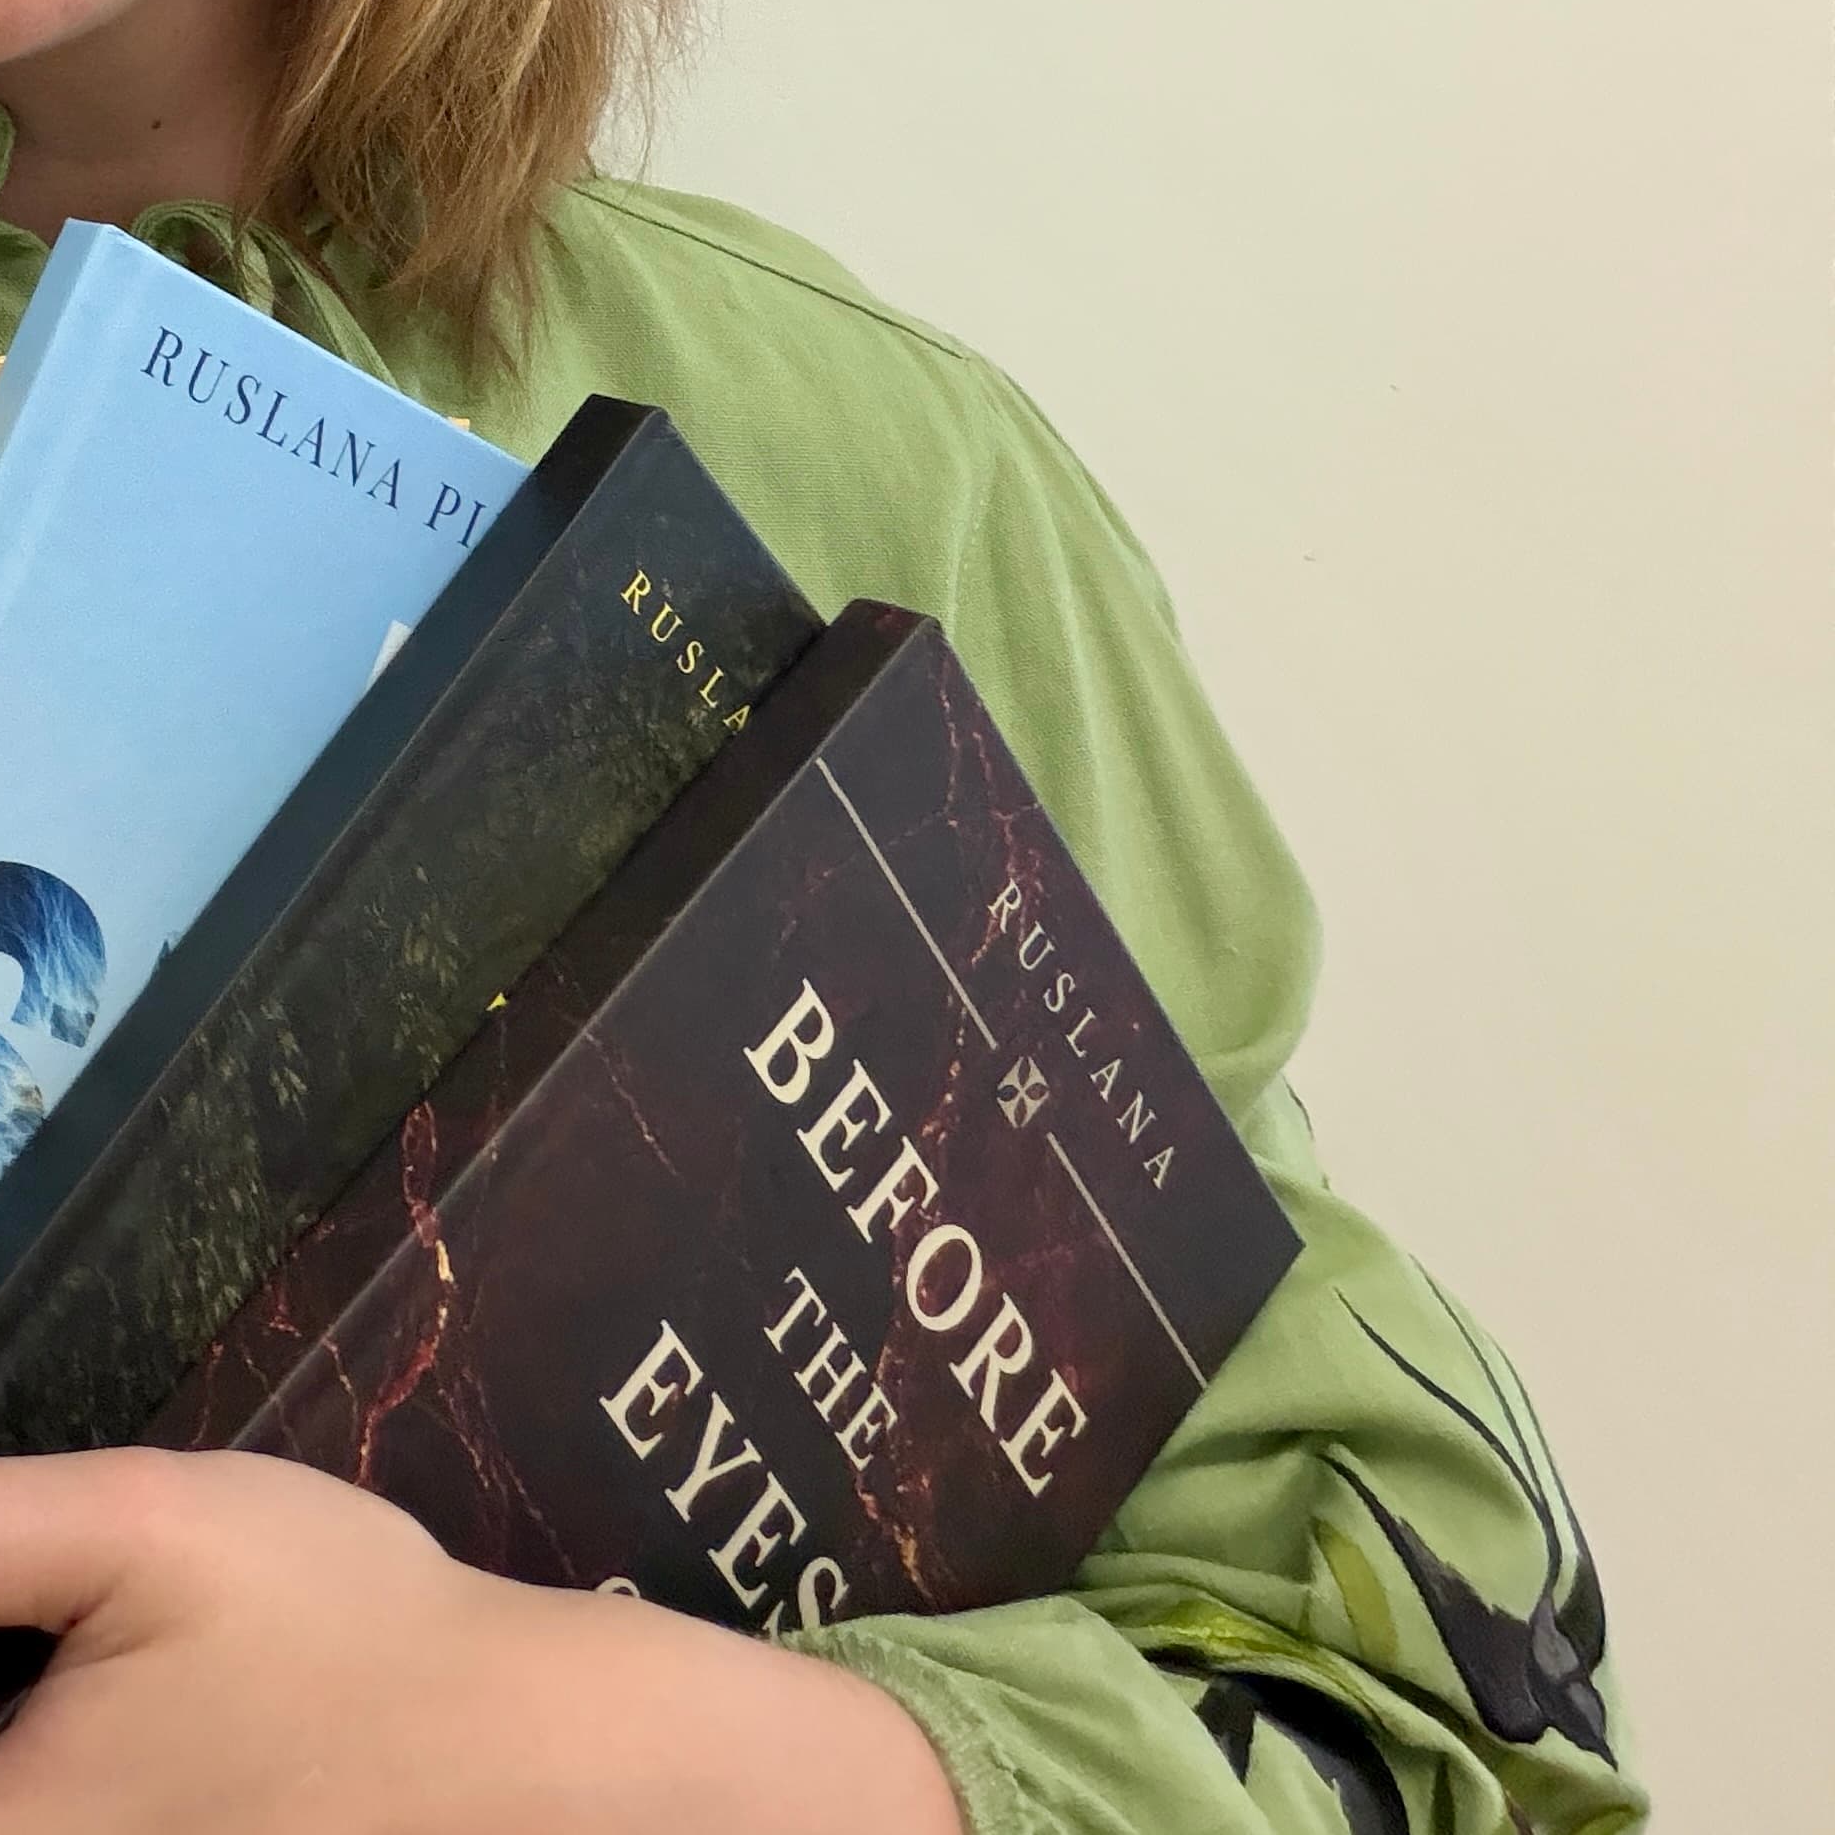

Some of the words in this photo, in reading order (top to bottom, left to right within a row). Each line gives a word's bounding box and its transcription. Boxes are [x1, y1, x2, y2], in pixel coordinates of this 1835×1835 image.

[140, 326, 402, 509] RUSLANA
[620, 568, 753, 734] RUSLA
[987, 877, 1177, 1191] RUSLANA
[743, 977, 1090, 1498] BEFORE
[598, 1319, 850, 1646] EYES
[763, 1266, 899, 1471] THE
